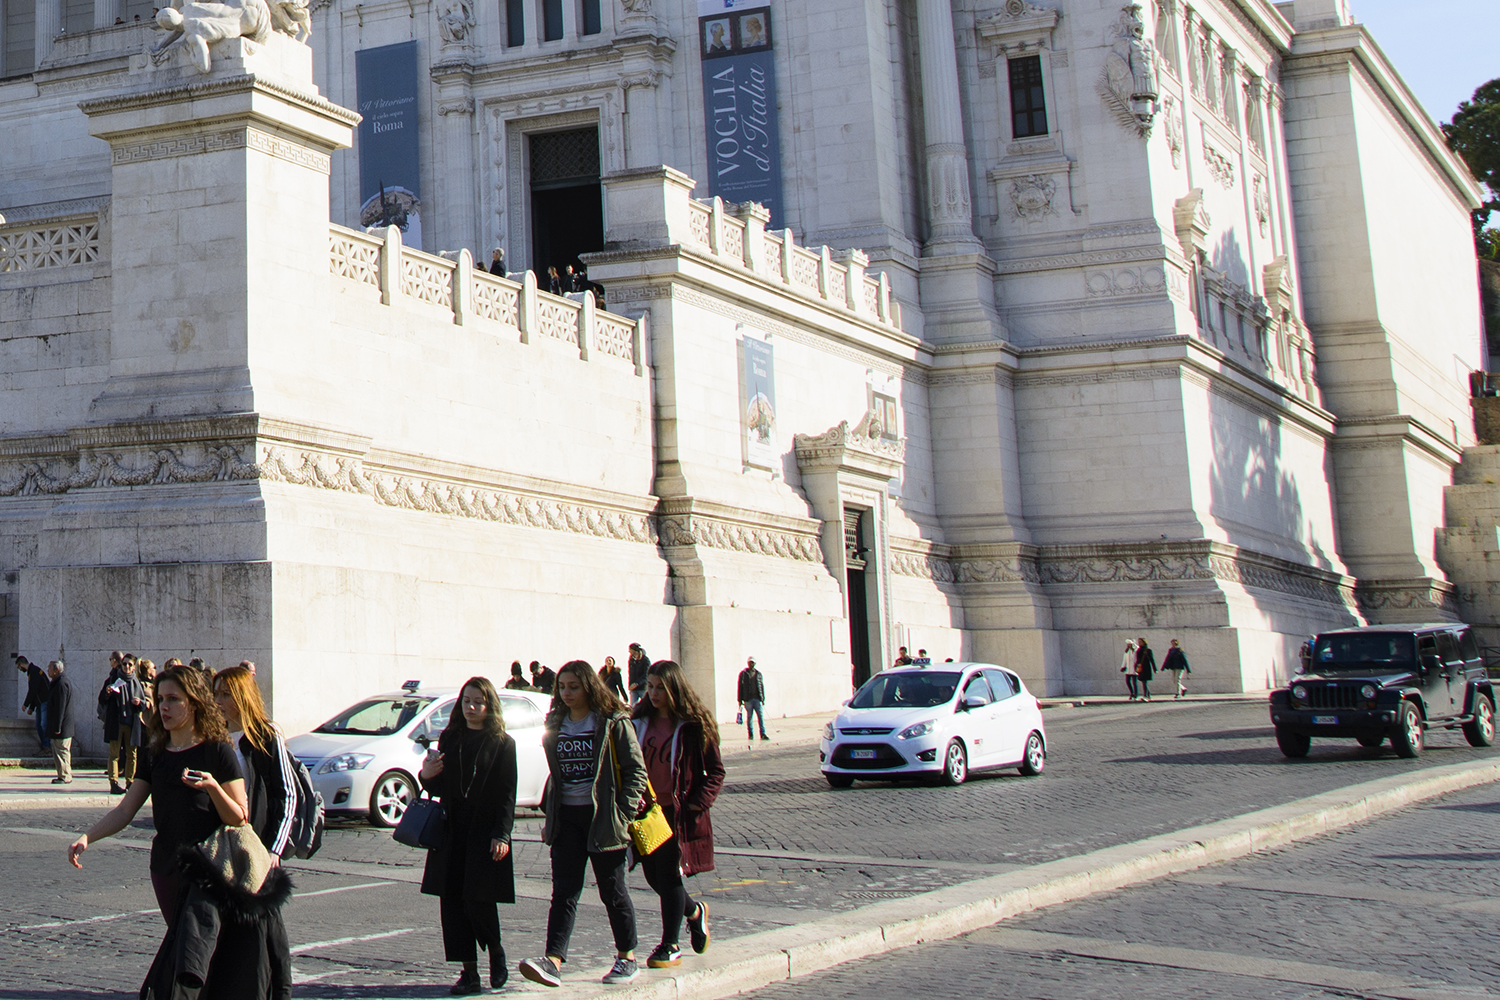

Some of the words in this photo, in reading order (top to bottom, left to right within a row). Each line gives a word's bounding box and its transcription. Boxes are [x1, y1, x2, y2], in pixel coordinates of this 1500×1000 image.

[374, 96, 414, 109] Vittoriano
[712, 64, 740, 178] VOGLIA
[739, 62, 770, 172] d'Italia
[373, 120, 404, 134] Roma
[557, 740, 592, 752] BORN
[560, 763, 594, 773] READY
